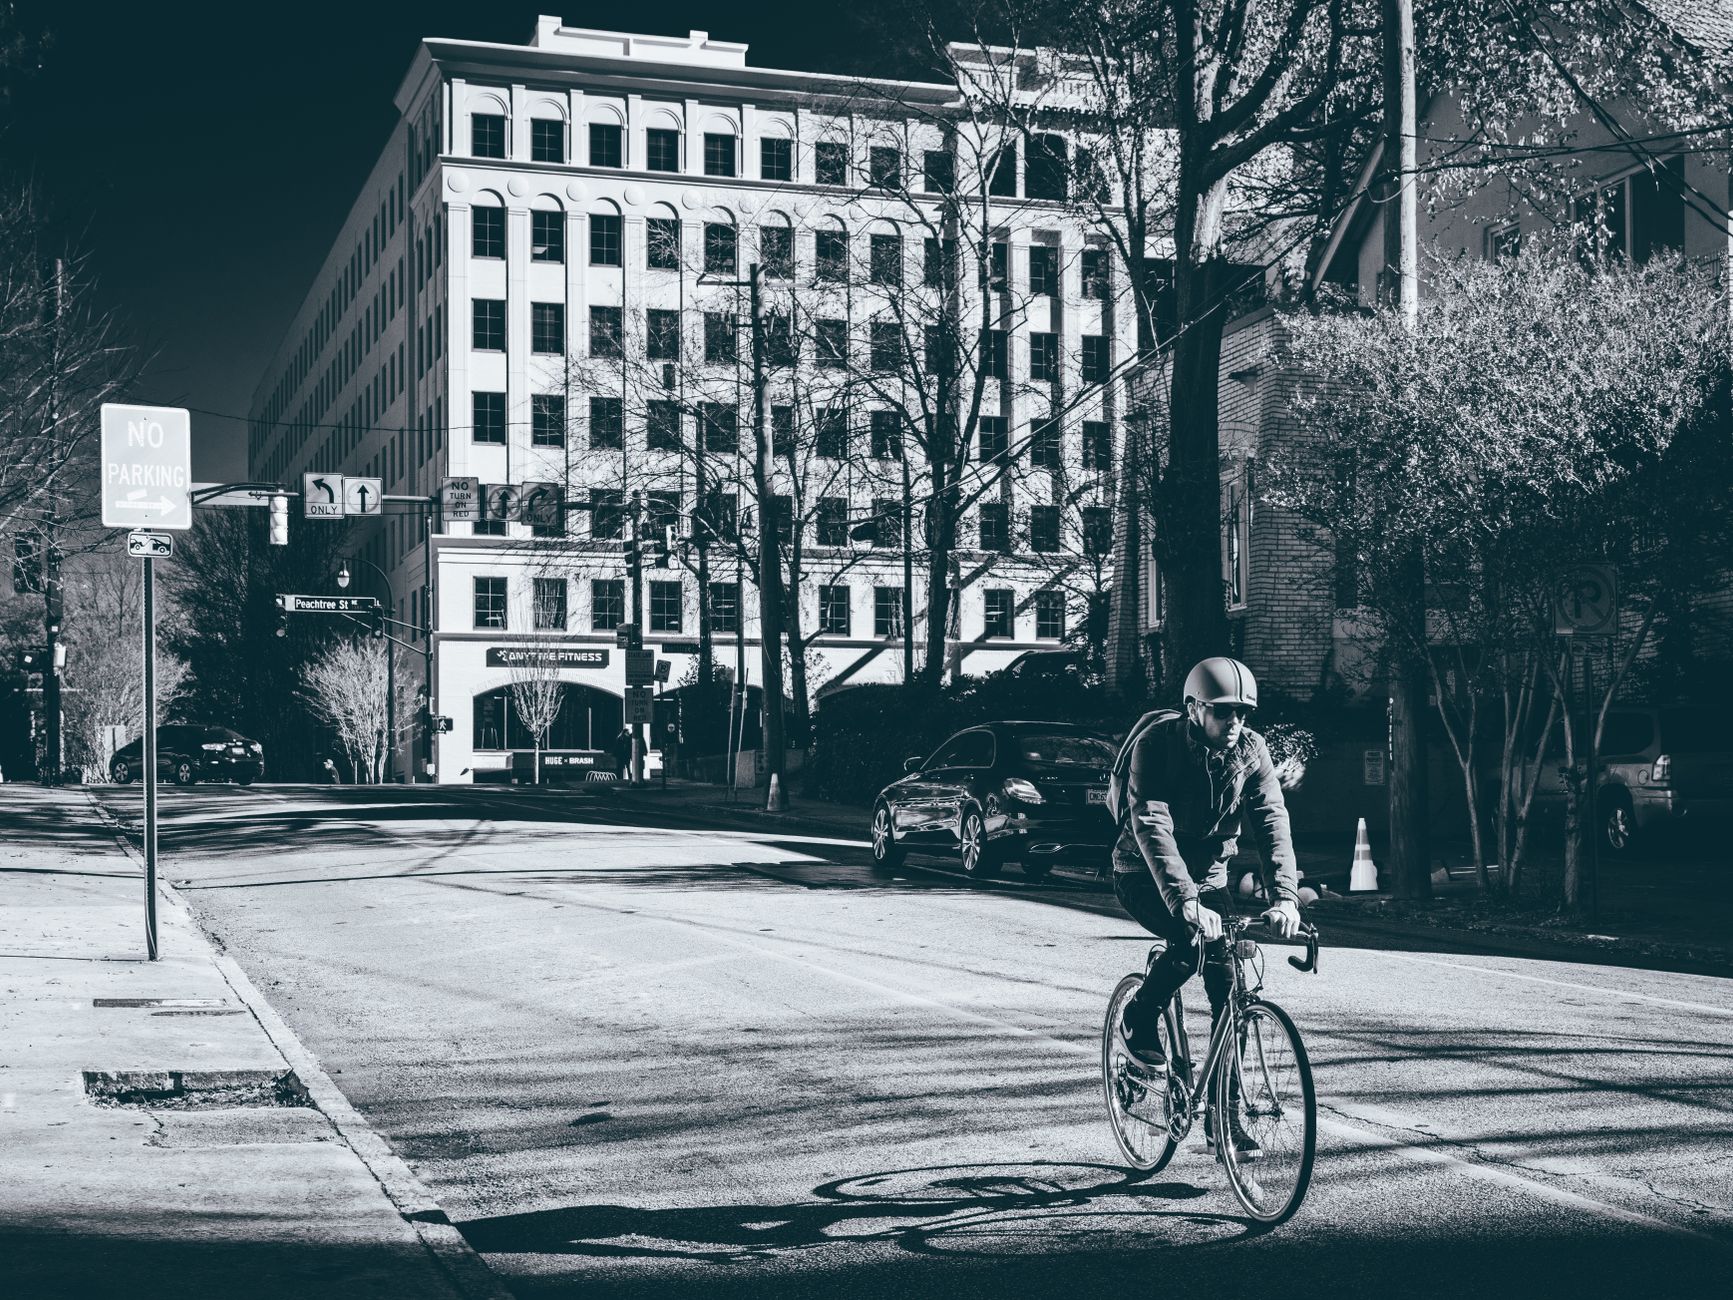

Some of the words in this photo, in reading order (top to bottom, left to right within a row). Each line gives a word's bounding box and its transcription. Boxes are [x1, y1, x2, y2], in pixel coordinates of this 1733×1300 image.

[127, 420, 165, 448] NO
[108, 463, 185, 488] PARKING
[451, 481, 469, 491] NO
[449, 492, 472, 500] TURN
[454, 501, 467, 509] ON
[310, 505, 338, 516] ONLY
[452, 510, 470, 518] RED
[526, 513, 552, 523] ONLY
[295, 598, 336, 610] Peachtree
[338, 599, 349, 610] St
[558, 652, 603, 662] FITNESS
[632, 690, 647, 698] NO
[544, 756, 563, 765] HUGE
[569, 757, 594, 765] BRASH
